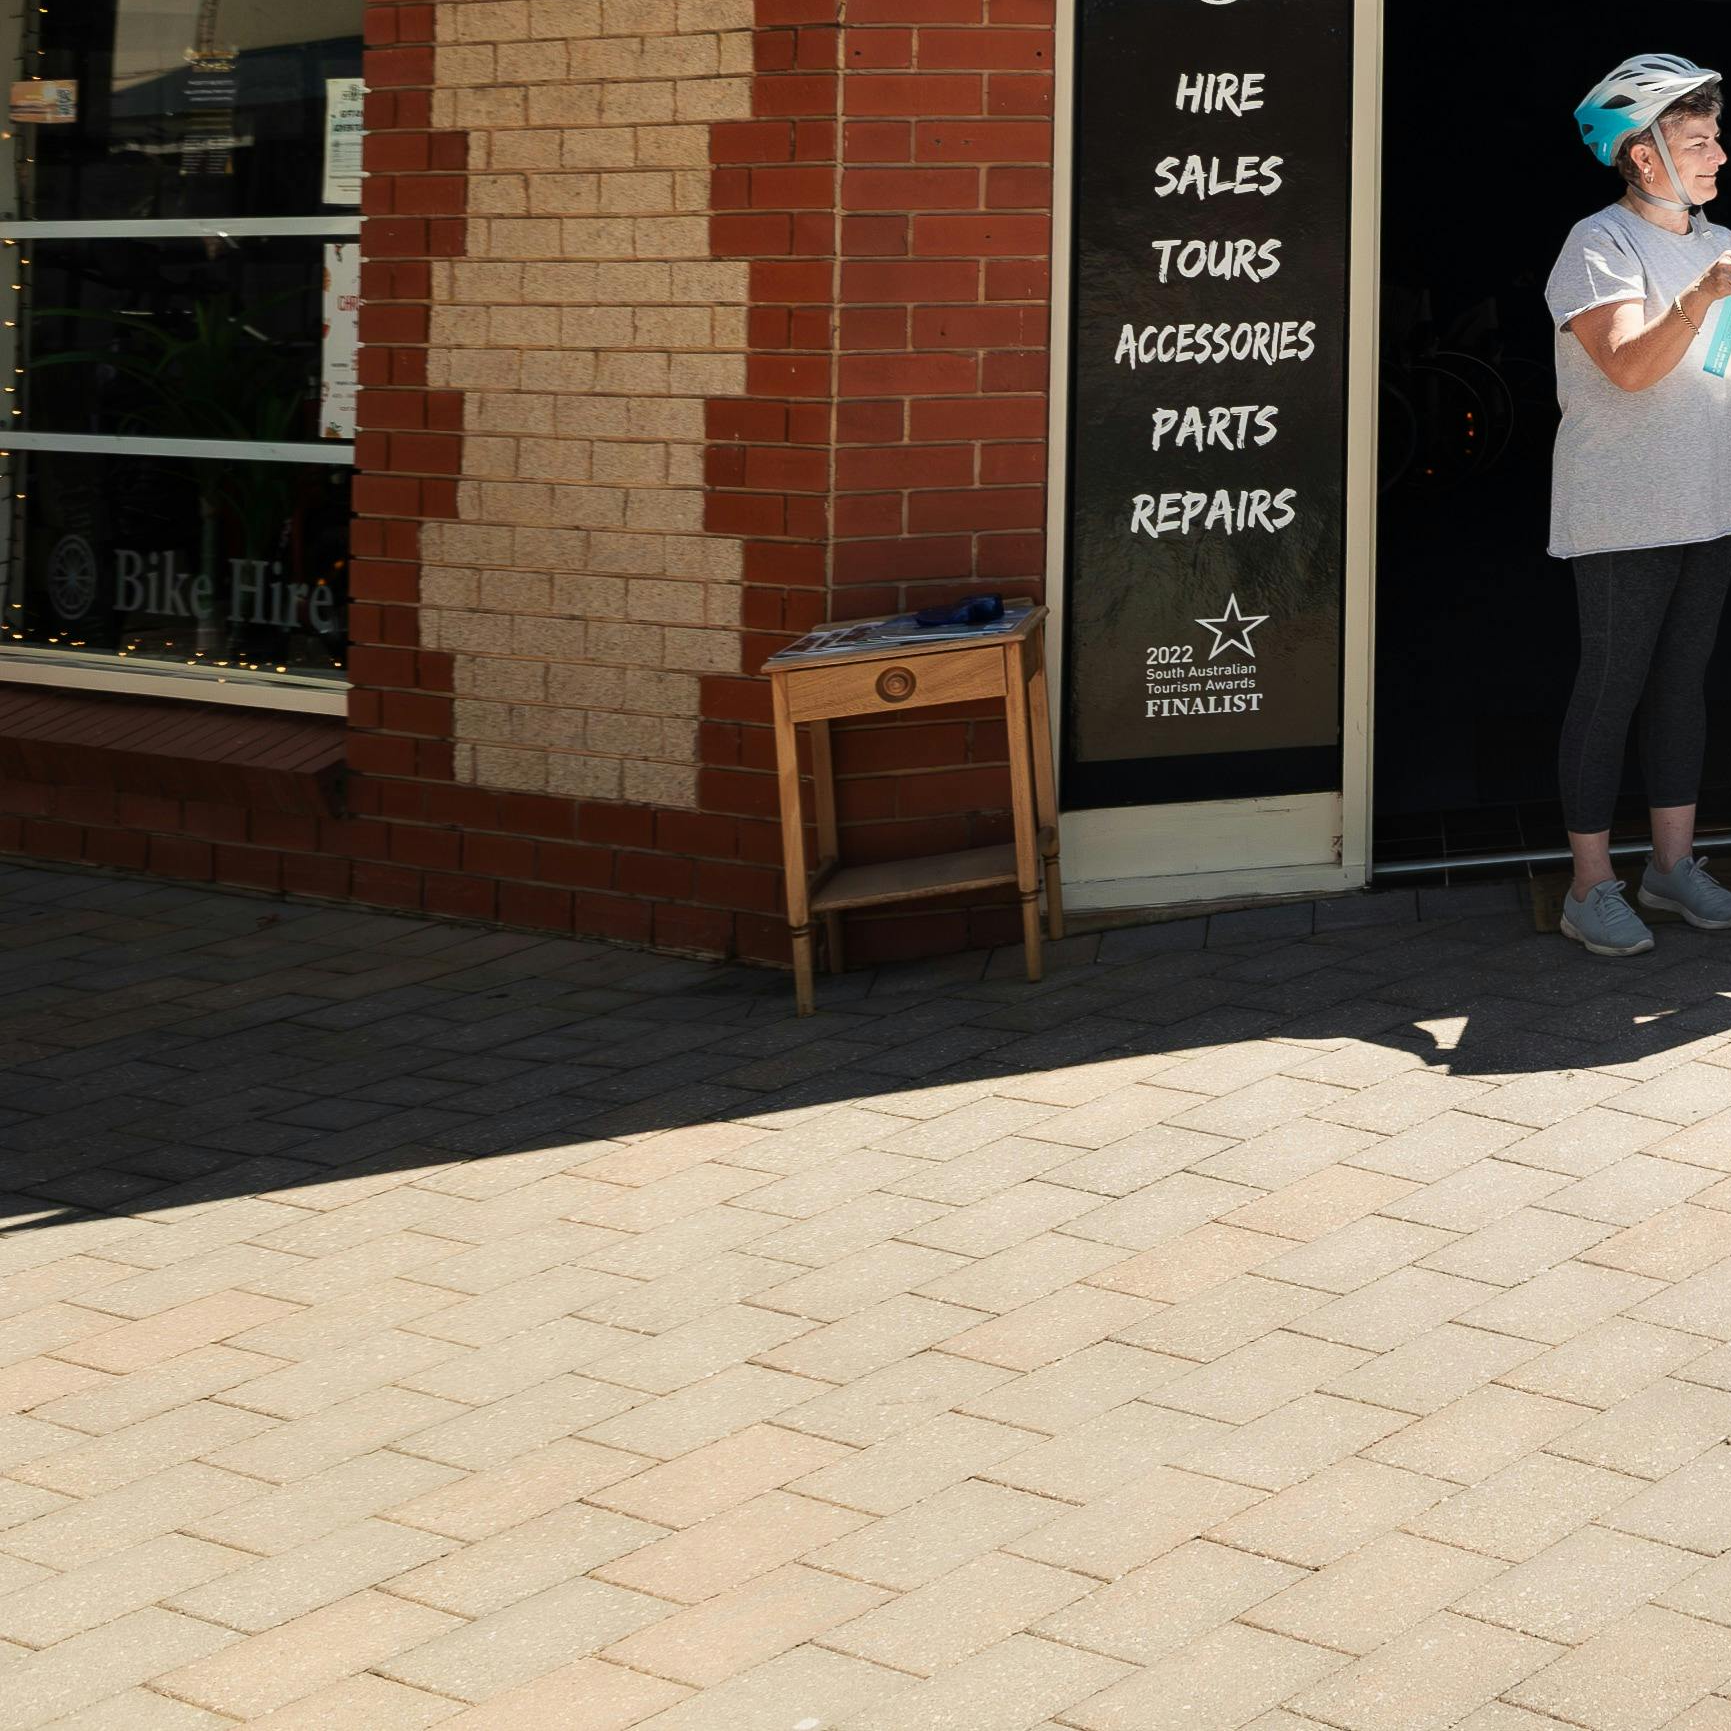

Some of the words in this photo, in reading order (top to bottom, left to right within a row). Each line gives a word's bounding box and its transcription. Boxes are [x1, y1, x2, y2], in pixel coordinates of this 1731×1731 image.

[1175, 72, 1266, 117] HIRE
[1154, 154, 1284, 201] SALES
[1150, 238, 1283, 284] TOURS
[1114, 320, 1316, 370] ACCESSORIES
[1151, 404, 1279, 452] PARTS
[1130, 487, 1298, 538] REPAIRS
[112, 548, 213, 618] Bike
[226, 557, 335, 634] Hire
[1146, 645, 1194, 665] 2022
[1146, 667, 1185, 680] South
[1188, 663, 1257, 677] Australian
[1145, 693, 1264, 718] FINALIST
[1146, 681, 1202, 695] Tourism
[1205, 677, 1256, 692] Awards
